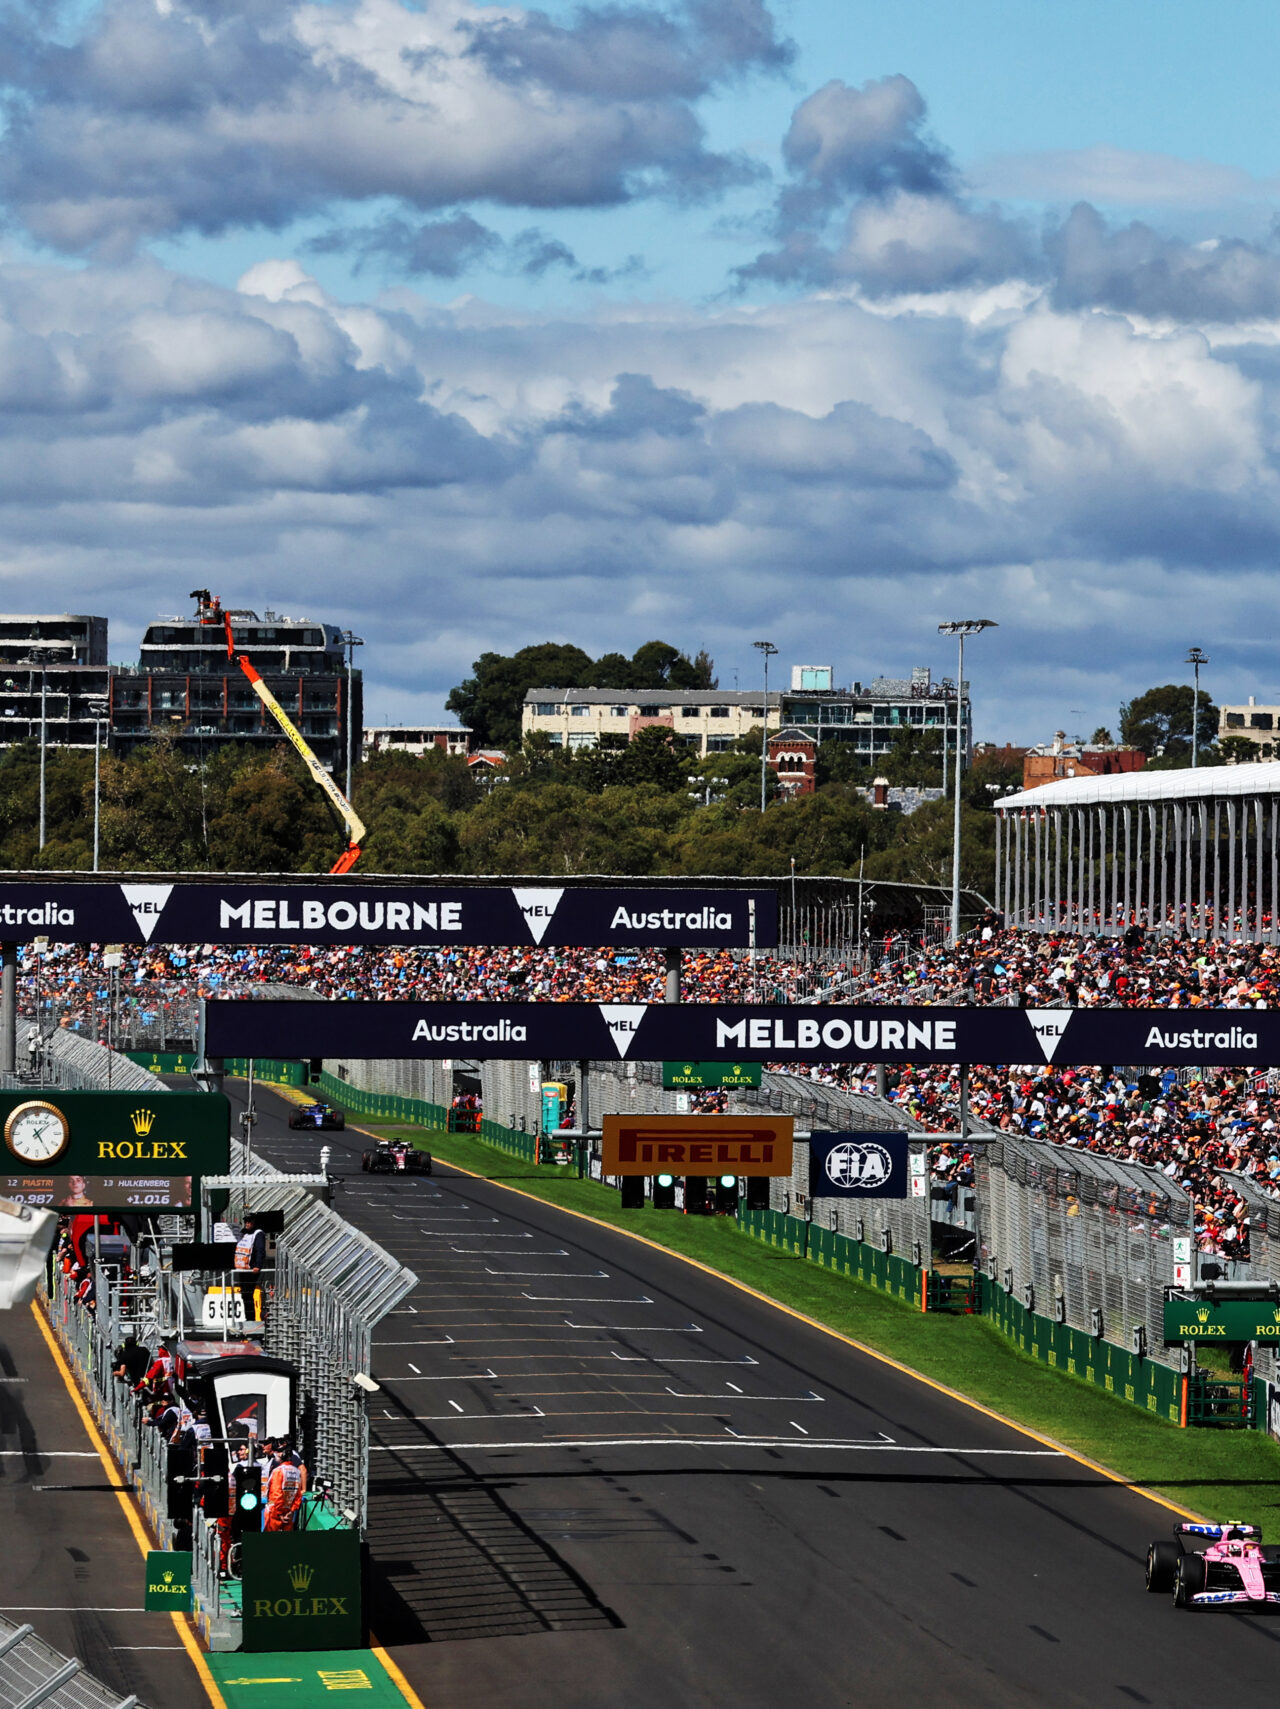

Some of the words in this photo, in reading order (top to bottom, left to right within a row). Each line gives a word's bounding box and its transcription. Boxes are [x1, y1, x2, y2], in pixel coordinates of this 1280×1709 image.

[0, 902, 74, 925] tralia
[130, 902, 163, 913] MEL
[521, 905, 553, 917] MEL
[219, 899, 463, 931] MELBOURNE
[609, 906, 732, 930] Australia
[411, 1018, 527, 1042] Australia
[606, 1020, 637, 1031] MEL
[1033, 1025, 1062, 1036] MEL
[716, 1018, 957, 1050] MELBOURNE
[1145, 1026, 1258, 1049] Australia
[672, 1076, 703, 1084] ROLEX
[722, 1076, 753, 1084] ROLEX
[97, 1141, 188, 1159] ROLEX
[618, 1128, 777, 1163] PIRELLI
[8, 1179, 18, 1187] 12
[117, 1179, 171, 1188] HULKENBERG
[126, 1194, 170, 1205] +1.016
[208, 1300, 216, 1319] 5
[1179, 1325, 1226, 1336] ROLEX
[149, 1584, 188, 1594] ROLEX
[253, 1597, 349, 1617] ROLEX
